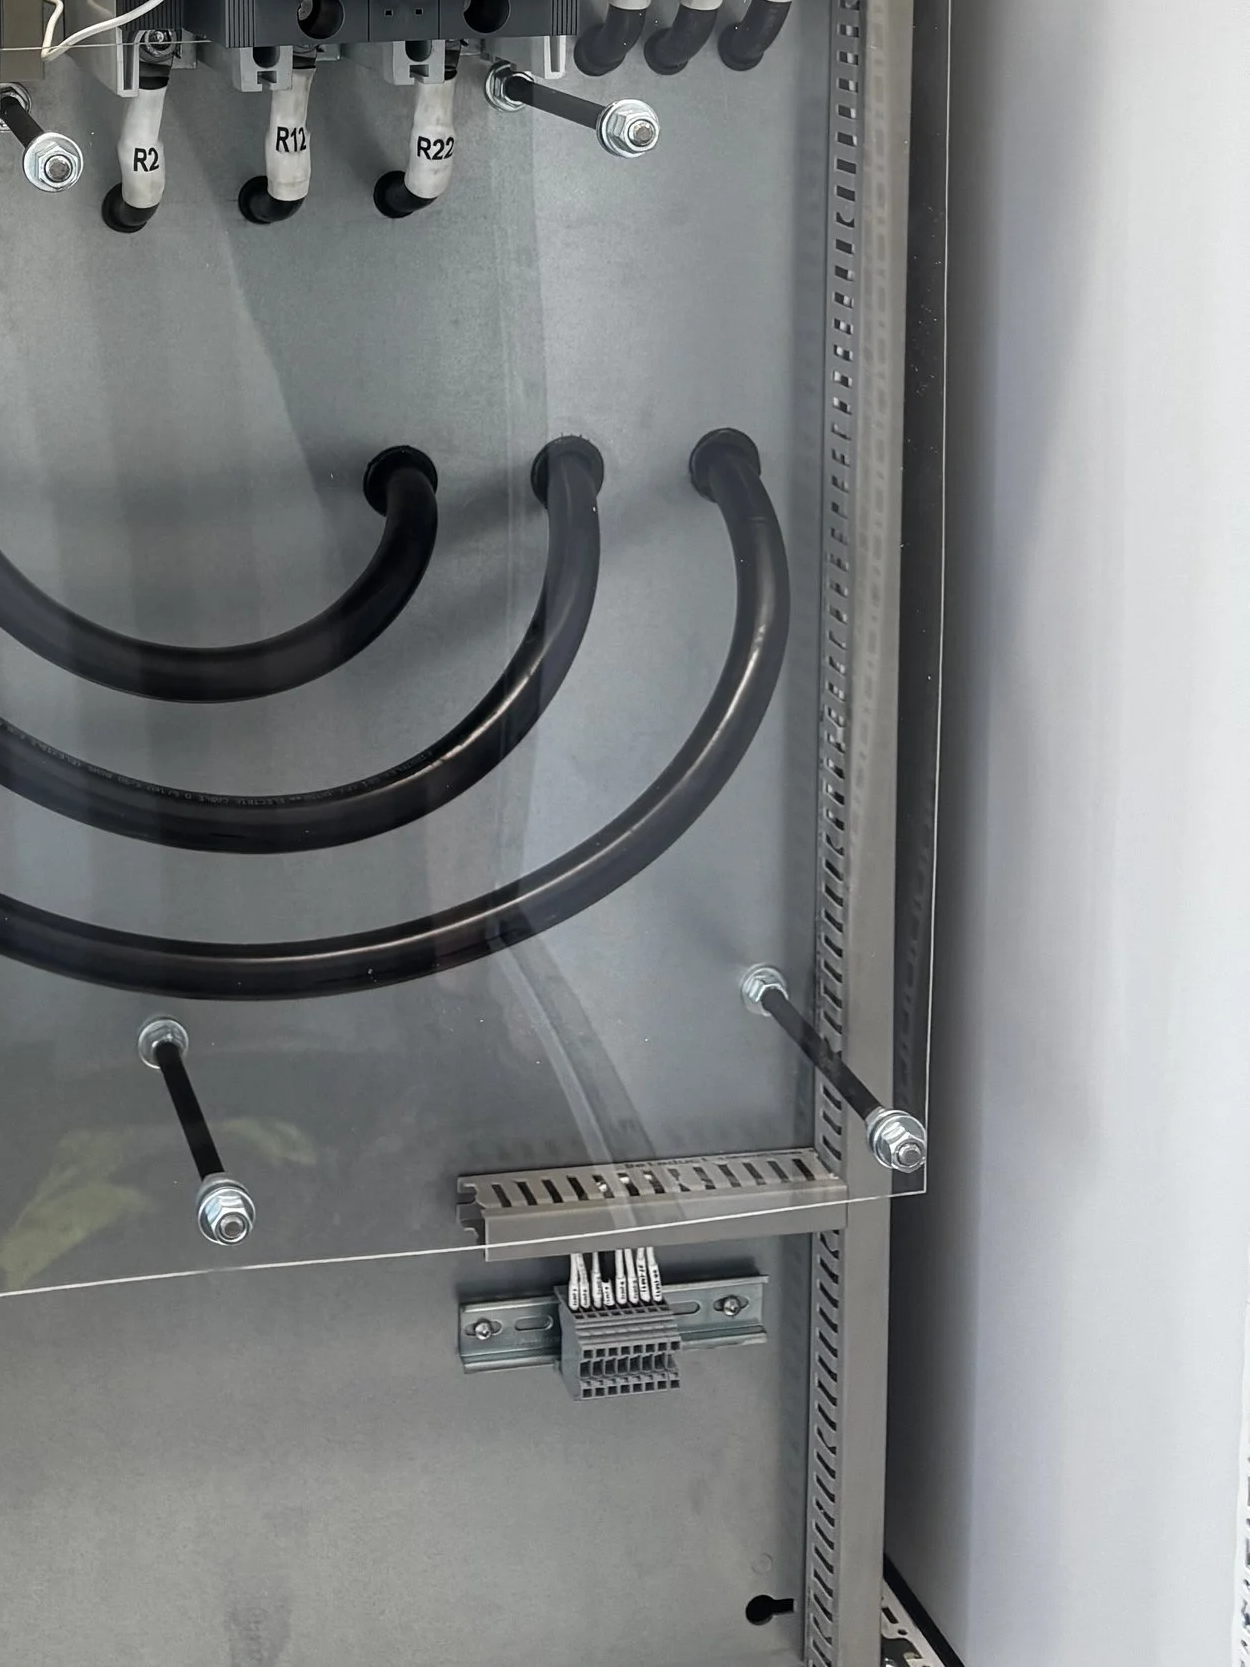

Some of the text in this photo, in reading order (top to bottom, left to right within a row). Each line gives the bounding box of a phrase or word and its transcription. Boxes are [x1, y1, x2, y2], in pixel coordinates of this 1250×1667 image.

[275, 125, 307, 153] R12
[416, 135, 455, 161] R22
[132, 146, 160, 172] R2
